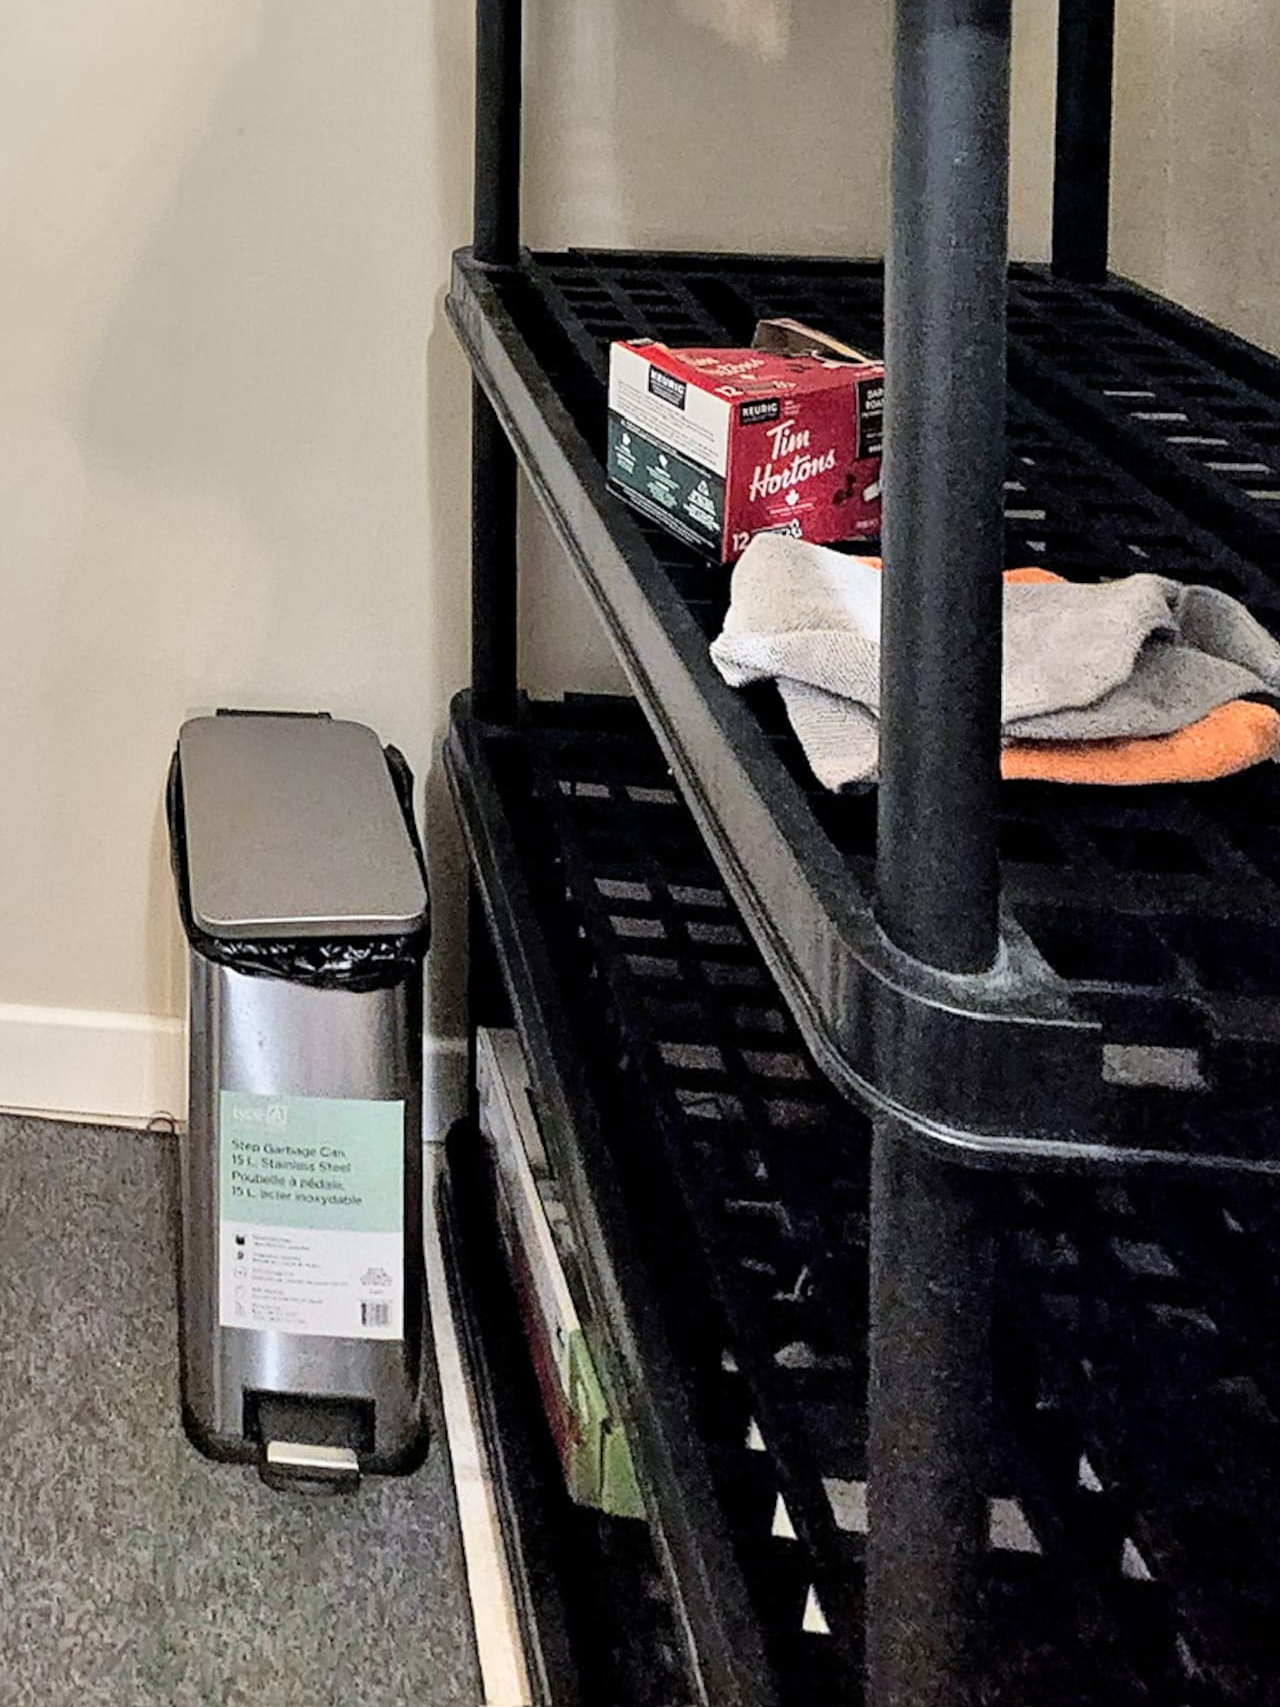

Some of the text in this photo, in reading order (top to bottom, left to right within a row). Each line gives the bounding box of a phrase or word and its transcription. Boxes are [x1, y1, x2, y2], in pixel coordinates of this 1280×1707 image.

[742, 402, 778, 417] KEURIG
[767, 419, 810, 460] Tim
[748, 448, 836, 502] Hortons
[732, 531, 750, 552] 12
[232, 1140, 260, 1153] Step
[263, 1143, 317, 1158] Garbage
[232, 1154, 244, 1165] 15
[261, 1157, 315, 1172] Stainless
[319, 1161, 351, 1173] Steel
[232, 1170, 286, 1185] Poubelle
[232, 1185, 244, 1196] 15
[295, 1192, 363, 1206] inoxydable
